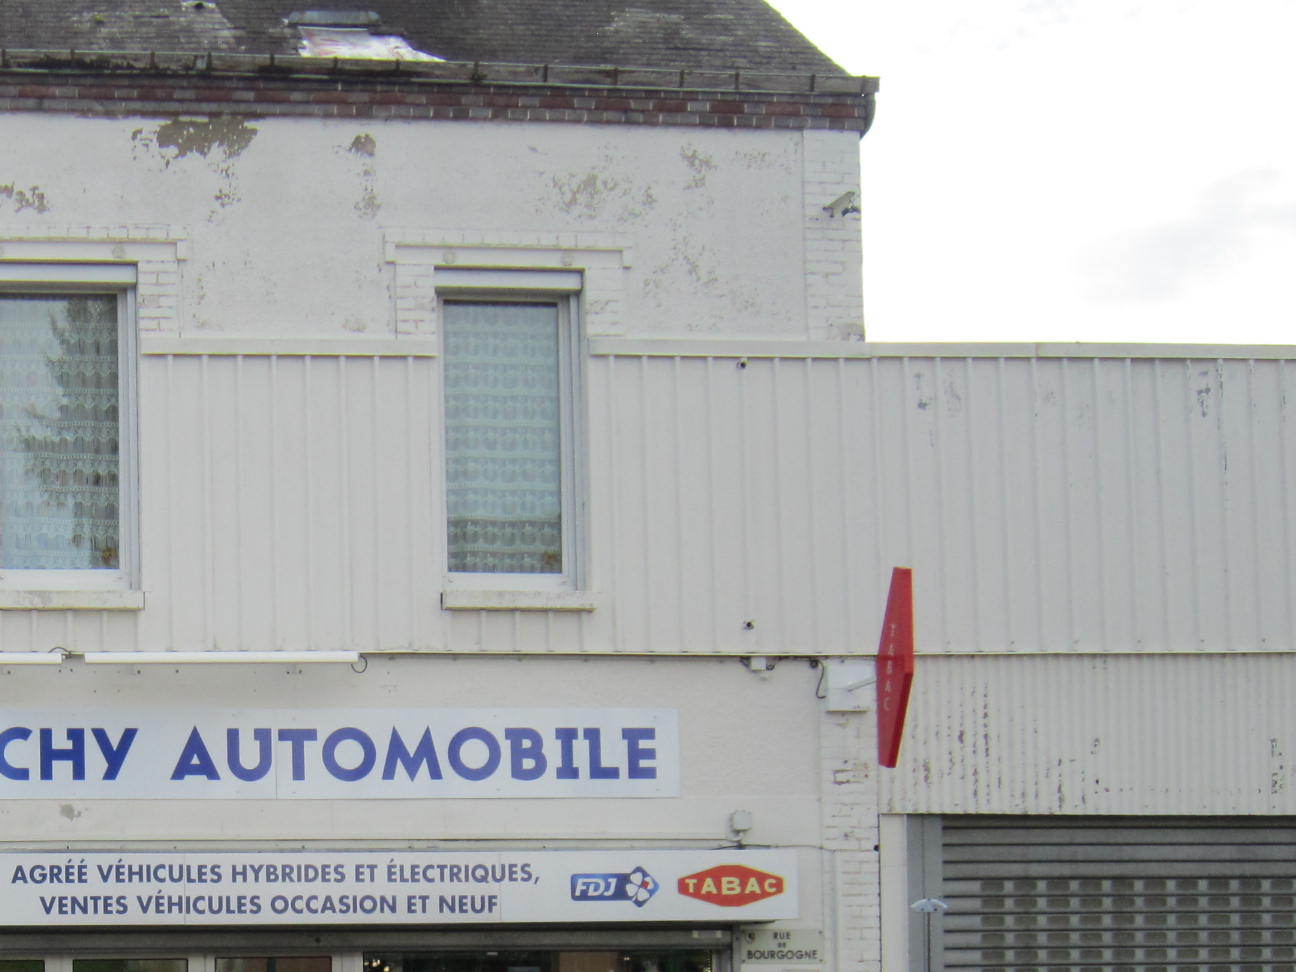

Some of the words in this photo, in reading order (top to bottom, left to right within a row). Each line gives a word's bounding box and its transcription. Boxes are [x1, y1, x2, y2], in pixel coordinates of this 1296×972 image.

[170, 725, 658, 783] AUTOMOBILE
[11, 859, 88, 884] AGRÉÉ
[96, 858, 223, 884] VÉHICULES
[231, 863, 346, 884] HYBRIDES
[354, 863, 378, 883] ET
[386, 857, 540, 885] ÉLECTRIQUES,
[574, 877, 618, 897] FDJ
[684, 876, 777, 896] TABAC
[40, 895, 129, 916] VENTES
[137, 889, 262, 916] VÉHICULES
[270, 894, 397, 915] OCCASION
[407, 894, 430, 914] ET
[438, 894, 500, 914] NEUF
[773, 931, 792, 940] RUE
[746, 949, 818, 961] BOURGOGNE
